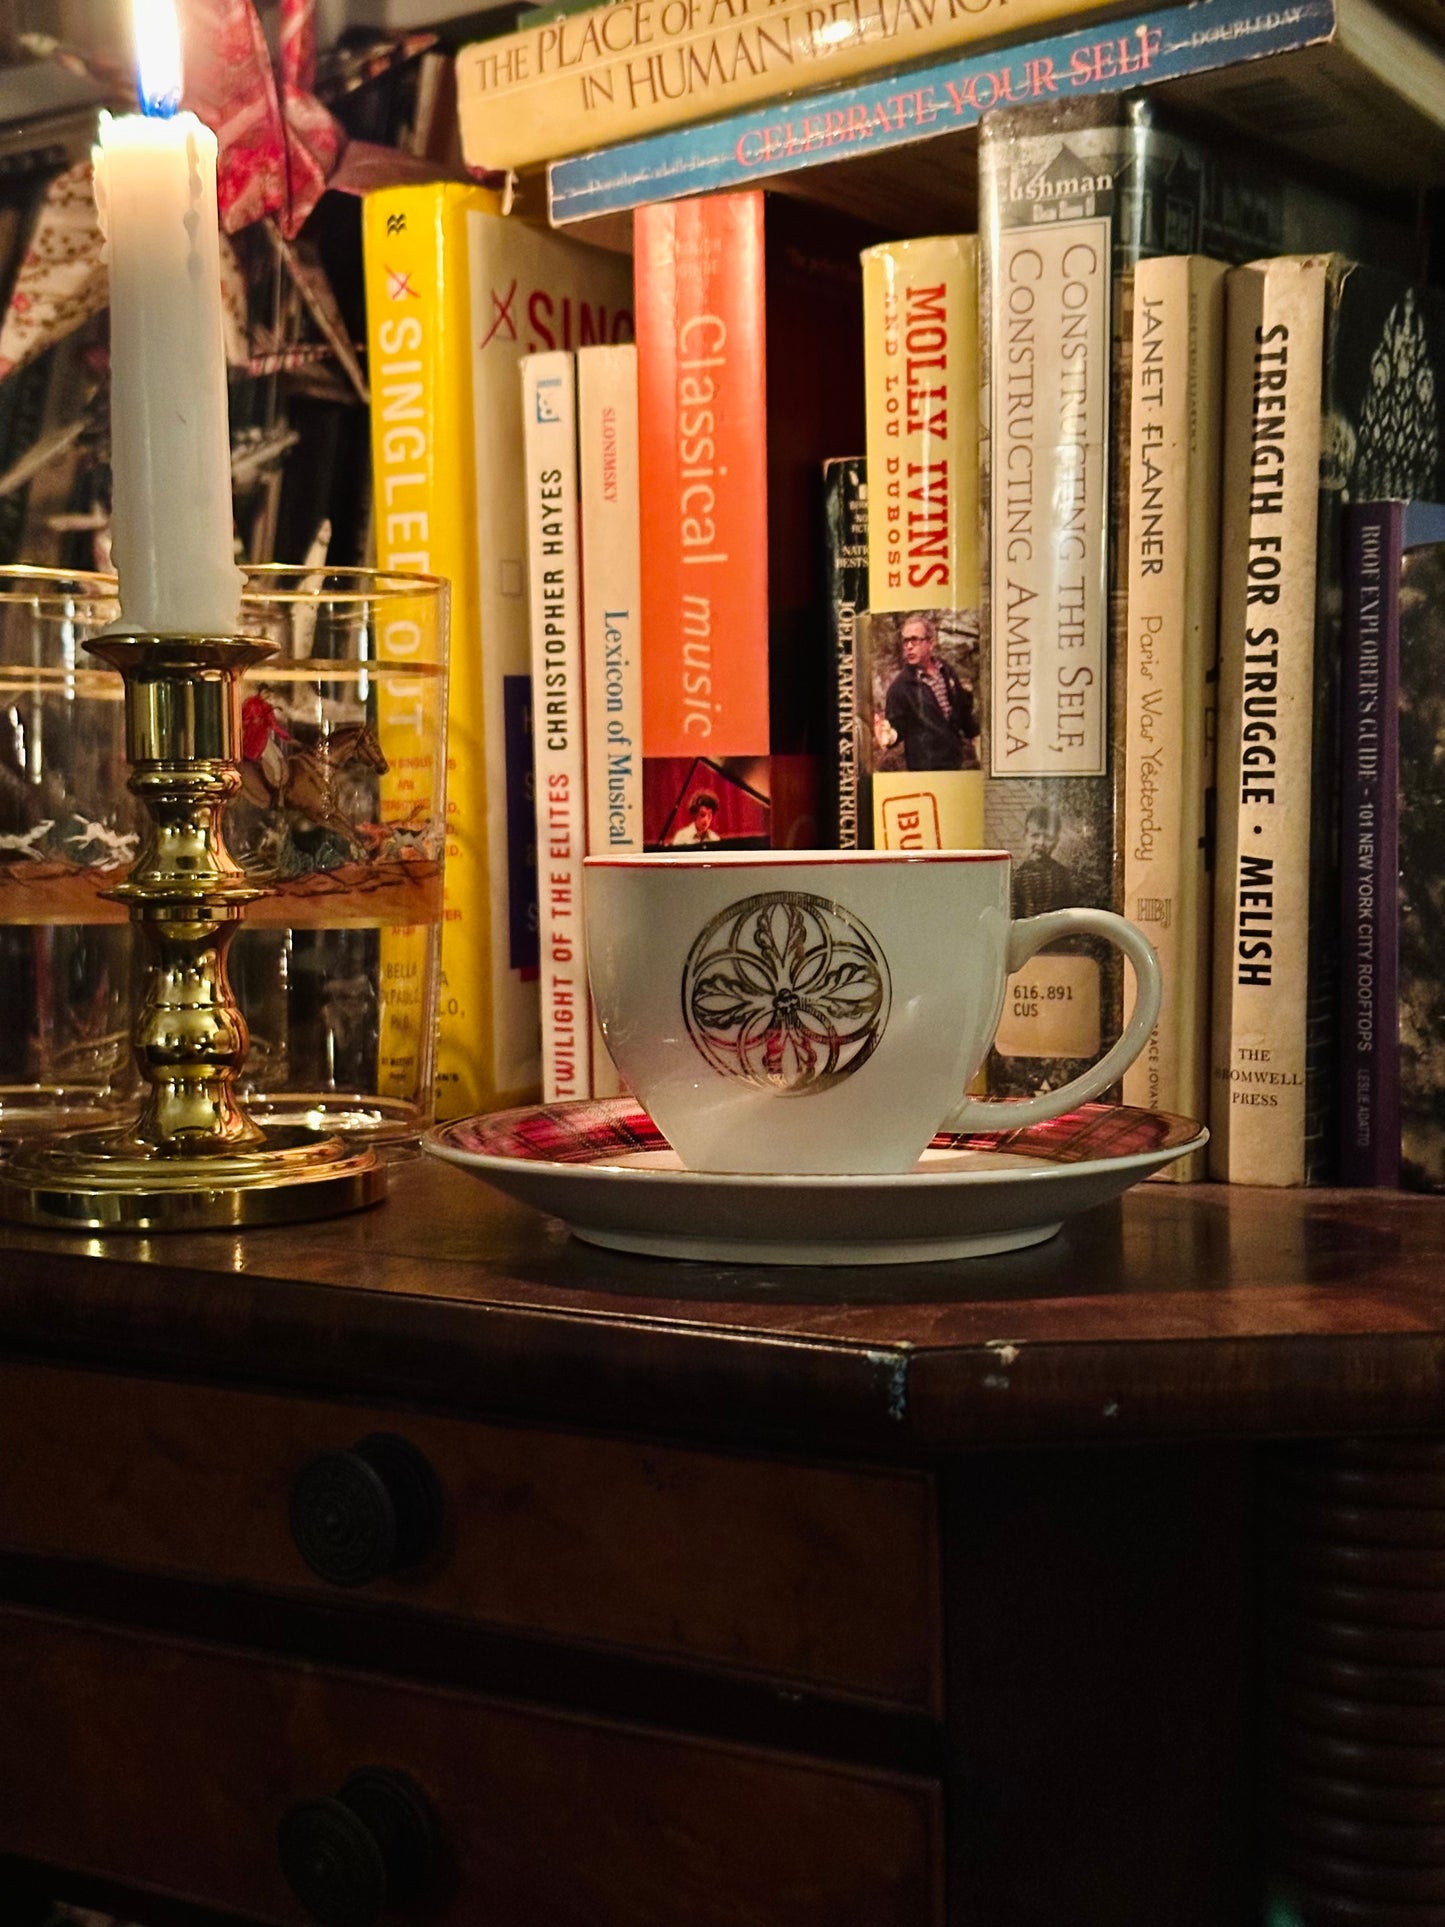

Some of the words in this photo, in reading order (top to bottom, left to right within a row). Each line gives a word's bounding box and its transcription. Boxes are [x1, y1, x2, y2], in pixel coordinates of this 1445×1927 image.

[475, 45, 530, 91] THE
[537, 2, 654, 74] PLACE
[661, 0, 703, 36] OF
[580, 68, 614, 111] IN
[626, 17, 794, 110] HUMAN
[804, 0, 1002, 58] BEHAV
[735, 85, 936, 167] CELEBRATE
[944, 58, 1055, 117] YOUR
[1069, 28, 1164, 87] SELF
[884, 291, 900, 356] AND
[905, 282, 949, 441] MOLLY
[679, 314, 728, 565] Classical
[886, 375, 900, 439] LOU
[1006, 248, 1043, 564] CONSTRUCTING
[1058, 242, 1097, 562] CONSTRUCTING
[1248, 322, 1289, 515] STRENGTH
[379, 316, 431, 590] SINGLED
[602, 407, 618, 504] SLONIMSKY
[541, 468, 564, 556] HAYES
[886, 456, 902, 588] DUBOSE
[906, 460, 950, 589] IVINS
[1140, 422, 1164, 578] FLANNER
[842, 546, 868, 557] NATI
[1246, 536, 1282, 607] FOR
[1360, 523, 1382, 580] ROOF
[838, 599, 857, 649] JOEL
[1058, 577, 1086, 651] THE
[1139, 615, 1164, 682] Paris
[1357, 584, 1381, 714] EXPLORER'S
[544, 569, 569, 751] CHRISTOPHER
[603, 609, 629, 718] Lexicon
[682, 594, 722, 739] music
[838, 654, 856, 733] MARTIN
[1005, 578, 1040, 758] AMERICA
[606, 728, 630, 748] of
[838, 738, 856, 755] &
[1048, 665, 1094, 753] SELF,
[1139, 688, 1164, 742] Was
[1241, 627, 1279, 806] STRUGGLE
[1356, 717, 1380, 783] GUIDE
[547, 772, 571, 871] ELITES
[607, 753, 634, 847] Musical
[838, 760, 857, 850] PATRICIA
[1135, 747, 1165, 862] Yesterday
[1358, 802, 1375, 826] 101
[1358, 832, 1375, 870] NEW
[549, 875, 573, 928] THE
[1237, 855, 1274, 987] MELISH
[1358, 873, 1374, 919] YORK
[550, 932, 573, 962] OF
[1357, 923, 1373, 960] CITY
[553, 973, 577, 1098] TWILIGHT
[1013, 985, 1074, 1002] 616.891
[1013, 1003, 1040, 1018] CUS
[1356, 964, 1373, 1051] ROOFTOPS
[1238, 1047, 1272, 1062] THE
[1231, 1092, 1279, 1107] PRESS
